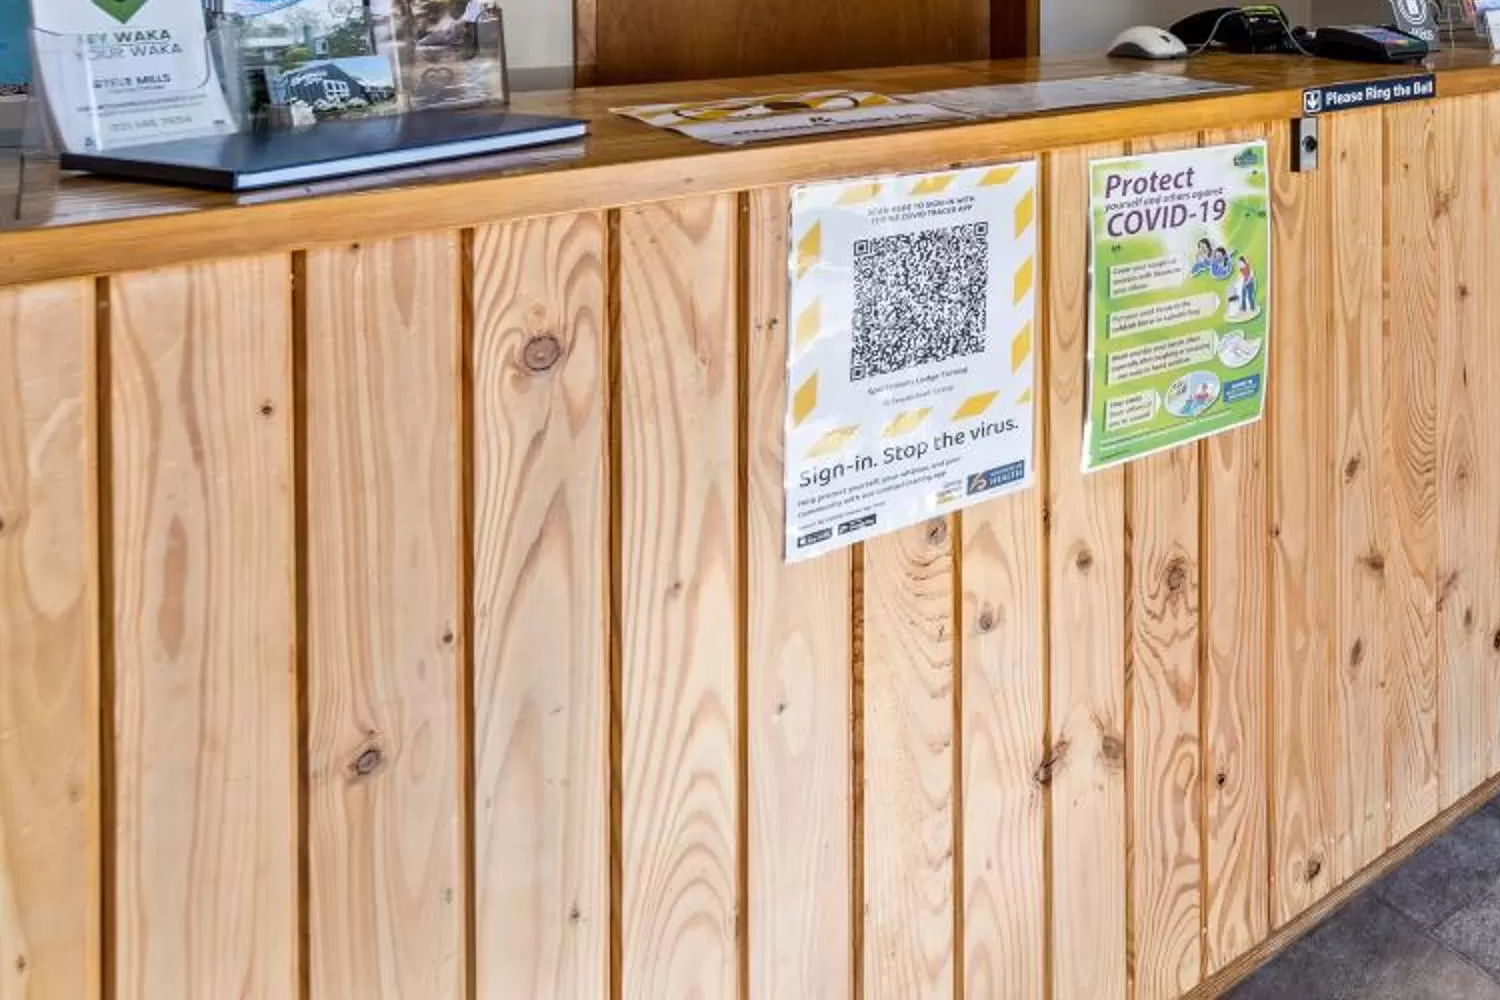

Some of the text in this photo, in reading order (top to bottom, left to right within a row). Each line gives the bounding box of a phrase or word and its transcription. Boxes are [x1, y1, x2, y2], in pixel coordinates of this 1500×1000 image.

[113, 29, 172, 43] WAKA
[130, 43, 184, 57] WAKA
[1325, 80, 1433, 106] Please Ring the Bell
[1105, 167, 1195, 198] Protect
[1107, 199, 1227, 238] COVID-19
[799, 417, 1020, 487] Sign-in. Stop the virus.
